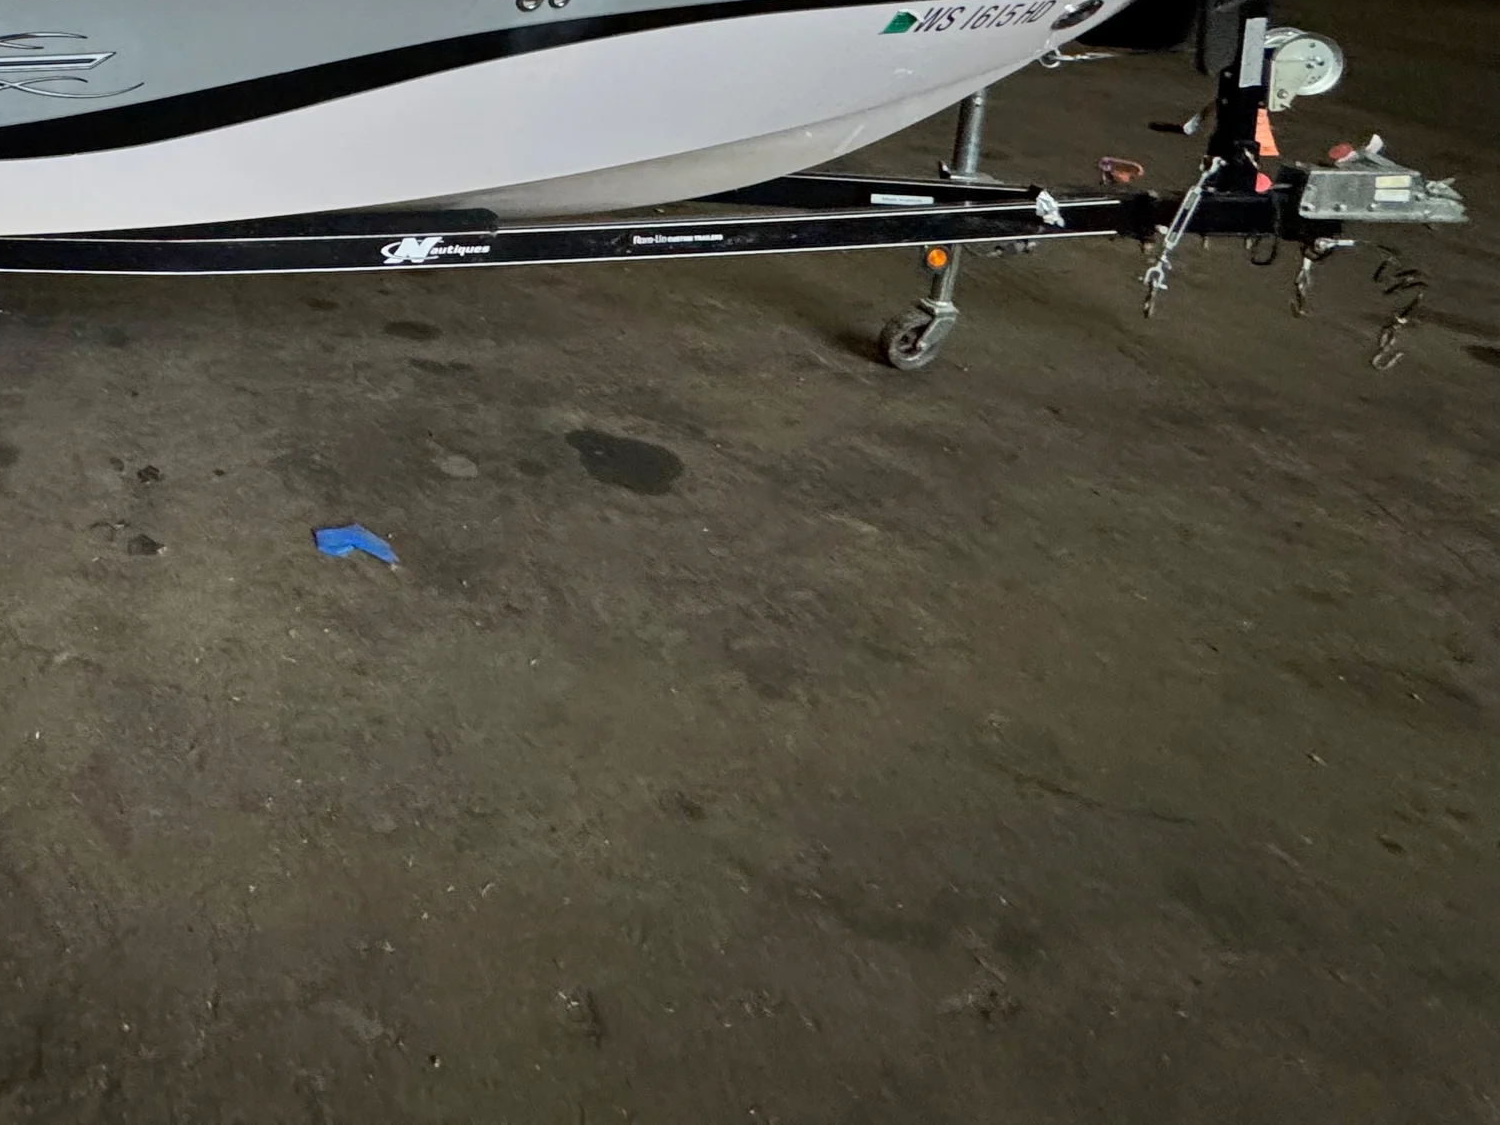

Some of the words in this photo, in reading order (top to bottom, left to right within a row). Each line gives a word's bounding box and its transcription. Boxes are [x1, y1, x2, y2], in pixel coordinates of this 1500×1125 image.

[913, 6, 966, 33] WS
[960, 4, 1025, 31] 1615
[381, 236, 491, 264] Nautiques
